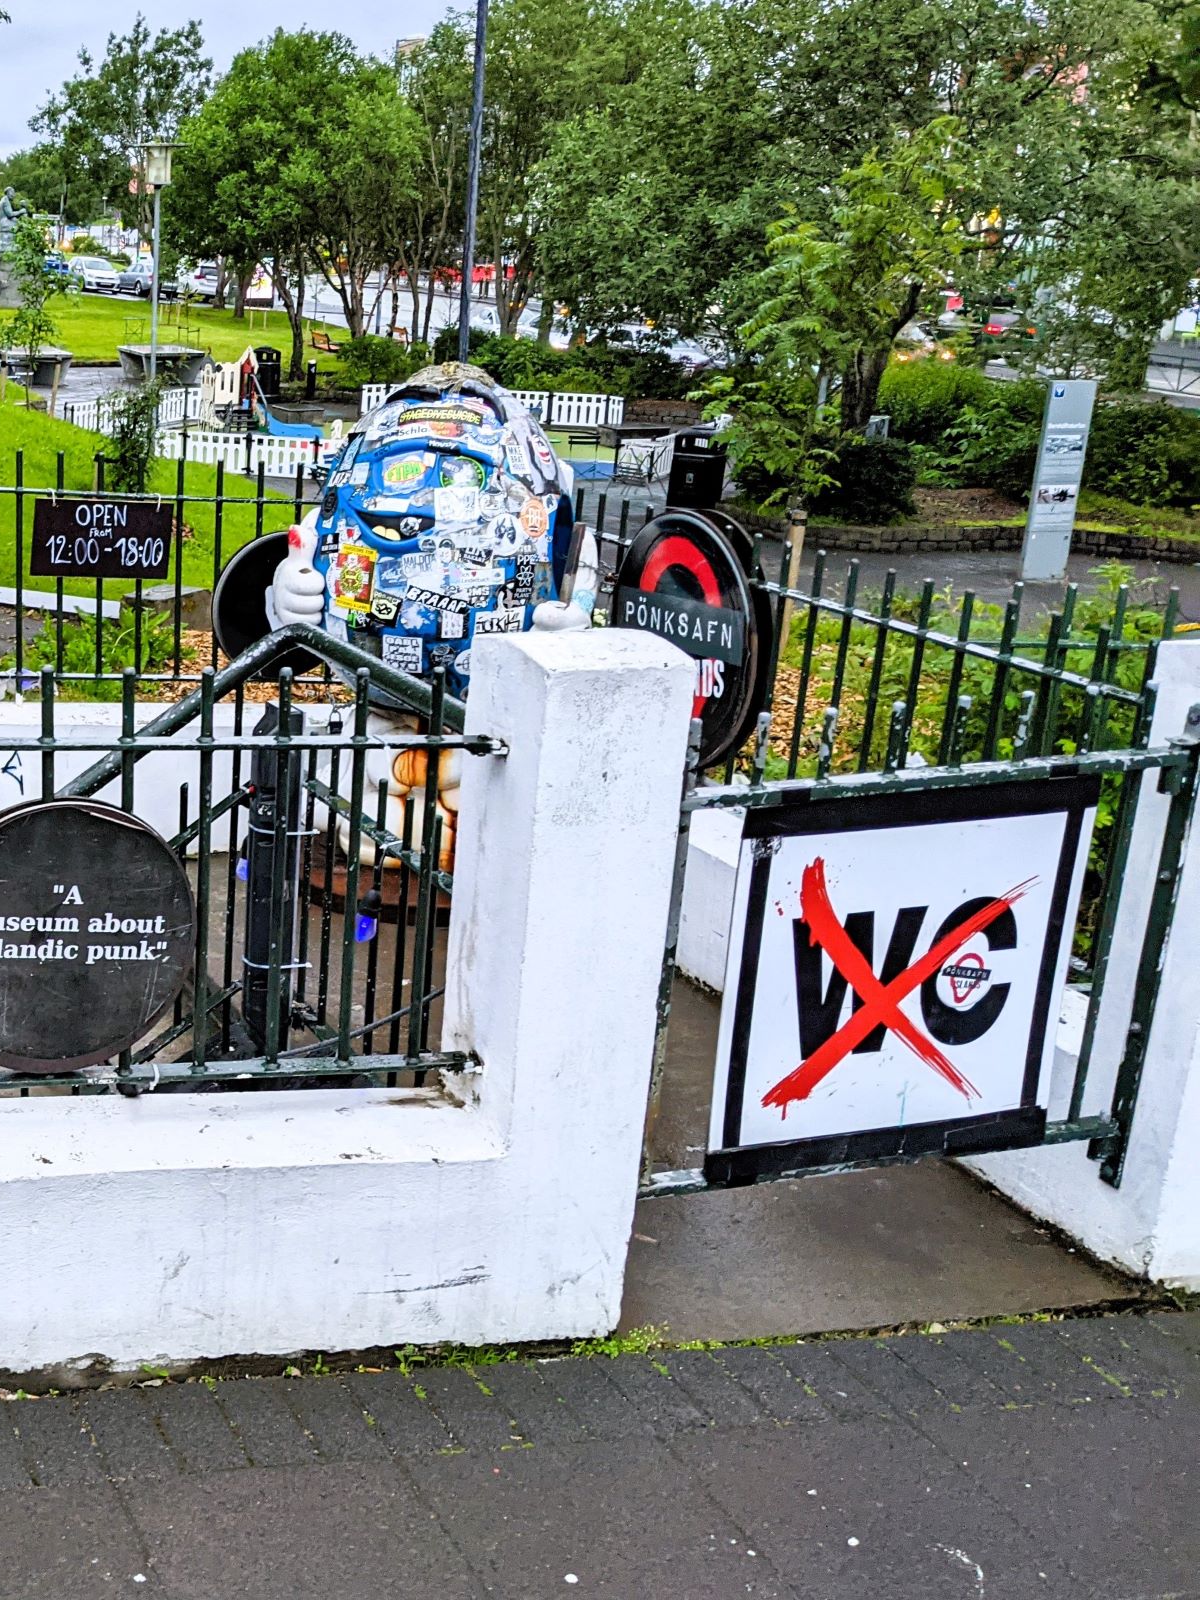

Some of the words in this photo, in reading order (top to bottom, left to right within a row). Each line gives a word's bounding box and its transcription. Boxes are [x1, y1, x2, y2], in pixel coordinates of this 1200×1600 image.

[75, 504, 128, 527] OPEN
[406, 587, 468, 614] BRAAAP
[624, 596, 733, 649] PÖNKSAFN
[87, 912, 166, 934] about
[792, 896, 1018, 1061] WC
[945, 967, 988, 979] PÖNKSAFN
